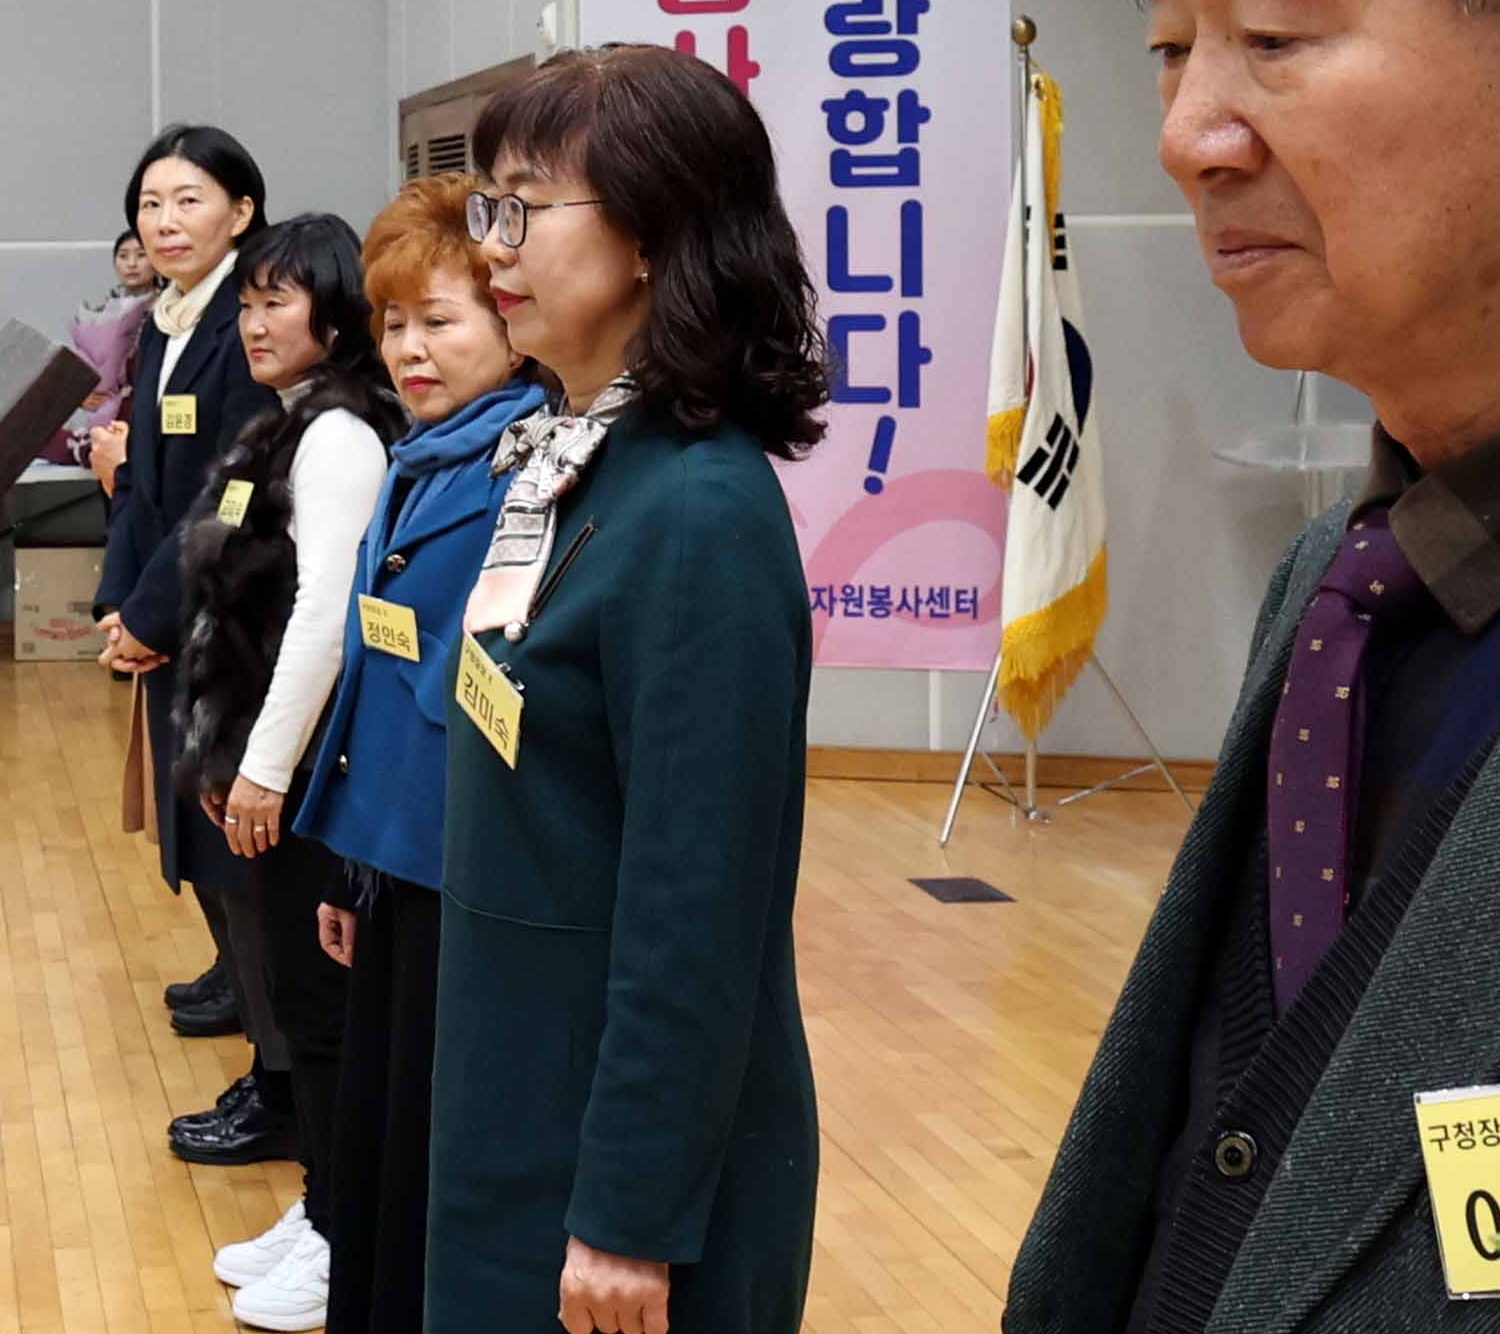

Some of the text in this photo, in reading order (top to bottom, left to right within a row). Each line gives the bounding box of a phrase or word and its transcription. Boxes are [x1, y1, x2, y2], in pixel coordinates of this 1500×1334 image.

[811, 584, 979, 619] 자원봉사센터
[367, 621, 410, 652] 정인숙
[463, 672, 510, 750] 김미숙
